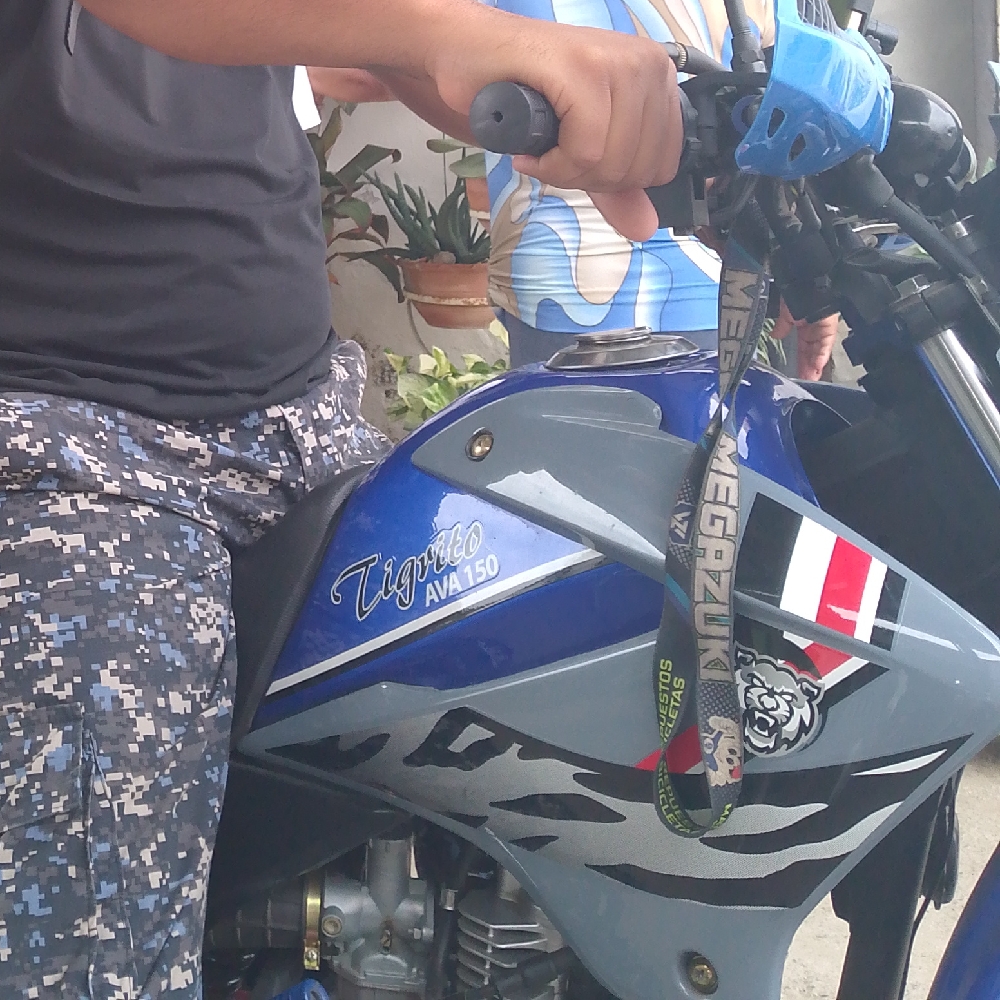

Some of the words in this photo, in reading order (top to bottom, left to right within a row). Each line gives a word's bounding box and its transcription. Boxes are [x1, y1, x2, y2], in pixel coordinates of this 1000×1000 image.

[330, 519, 483, 621] Tigrito
[424, 571, 463, 608] AVA
[463, 553, 500, 588] 150
[694, 431, 740, 683] MEGAZUKI
